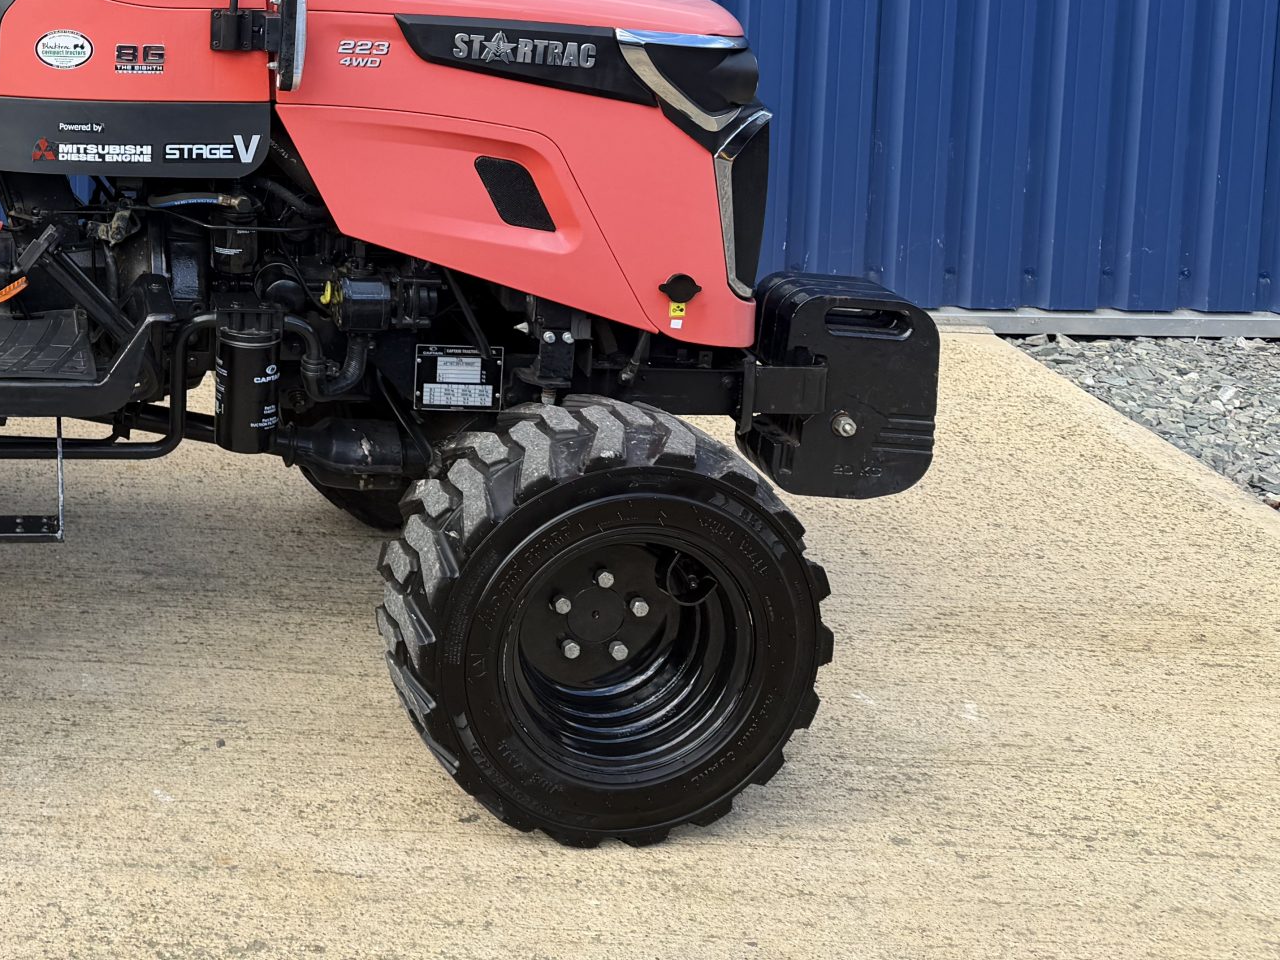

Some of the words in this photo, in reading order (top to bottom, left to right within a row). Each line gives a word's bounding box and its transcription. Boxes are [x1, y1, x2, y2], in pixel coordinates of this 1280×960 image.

[337, 40, 391, 55] 223
[339, 56, 381, 68] 4WD
[58, 122, 91, 132] Powered
[93, 123, 103, 134] by
[58, 143, 152, 154] MITSUBISHI
[165, 144, 234, 159] STAGE
[233, 134, 261, 163] V
[58, 153, 102, 162] DIESEL
[105, 153, 152, 163] ENGINE
